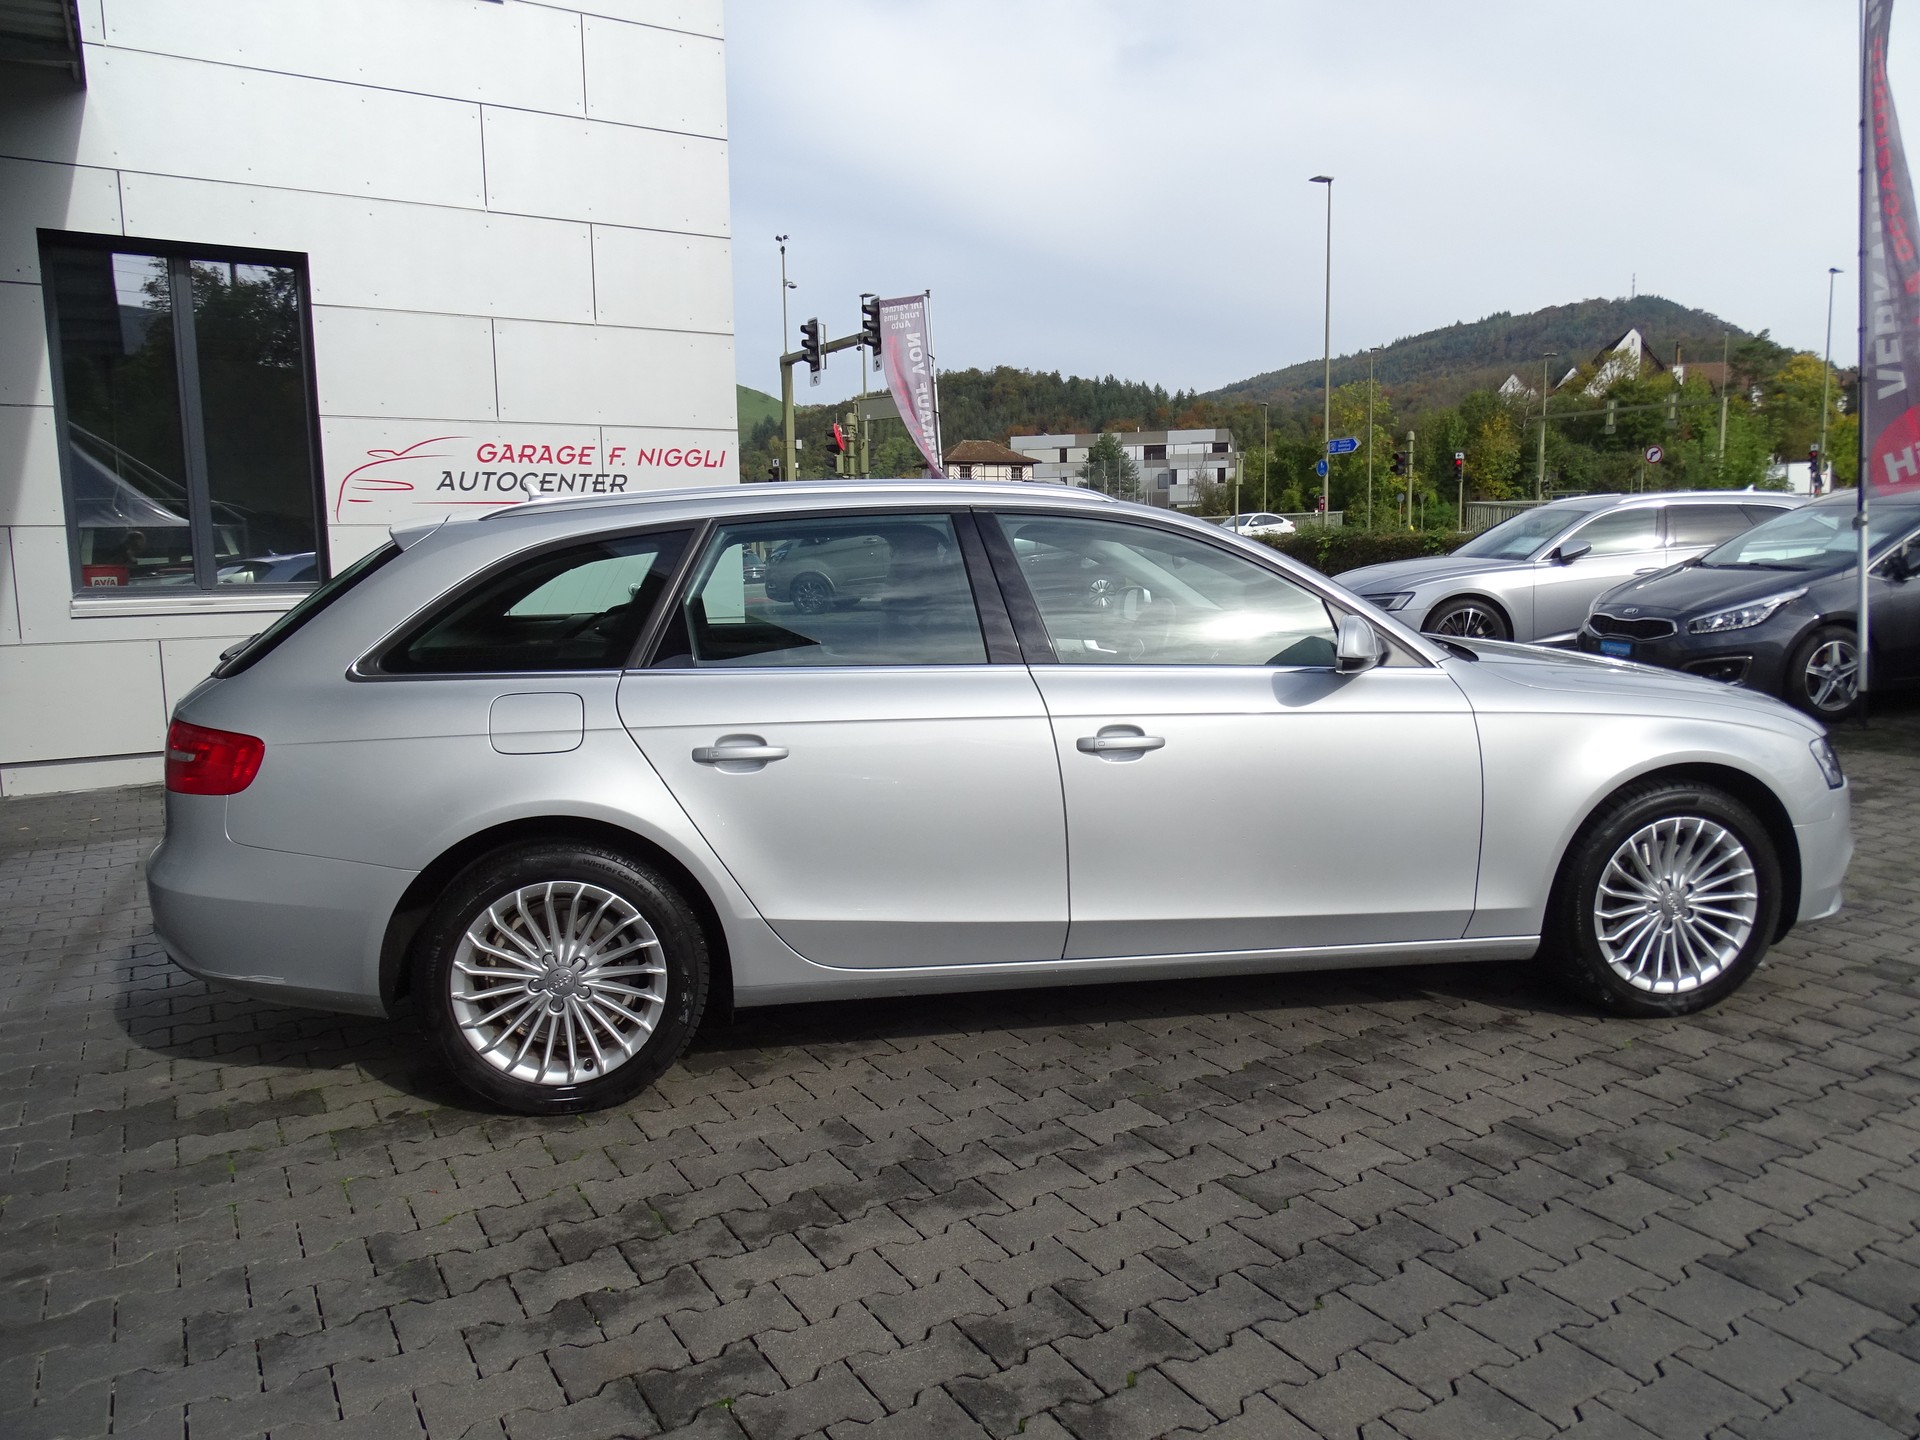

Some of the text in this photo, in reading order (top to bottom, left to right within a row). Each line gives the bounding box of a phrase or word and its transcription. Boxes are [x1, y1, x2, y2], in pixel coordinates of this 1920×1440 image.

[1871, 172, 1907, 400] VERK
[477, 443, 726, 468] GARAGE F. NIGGLI
[436, 470, 628, 493] AUTOCENTER
